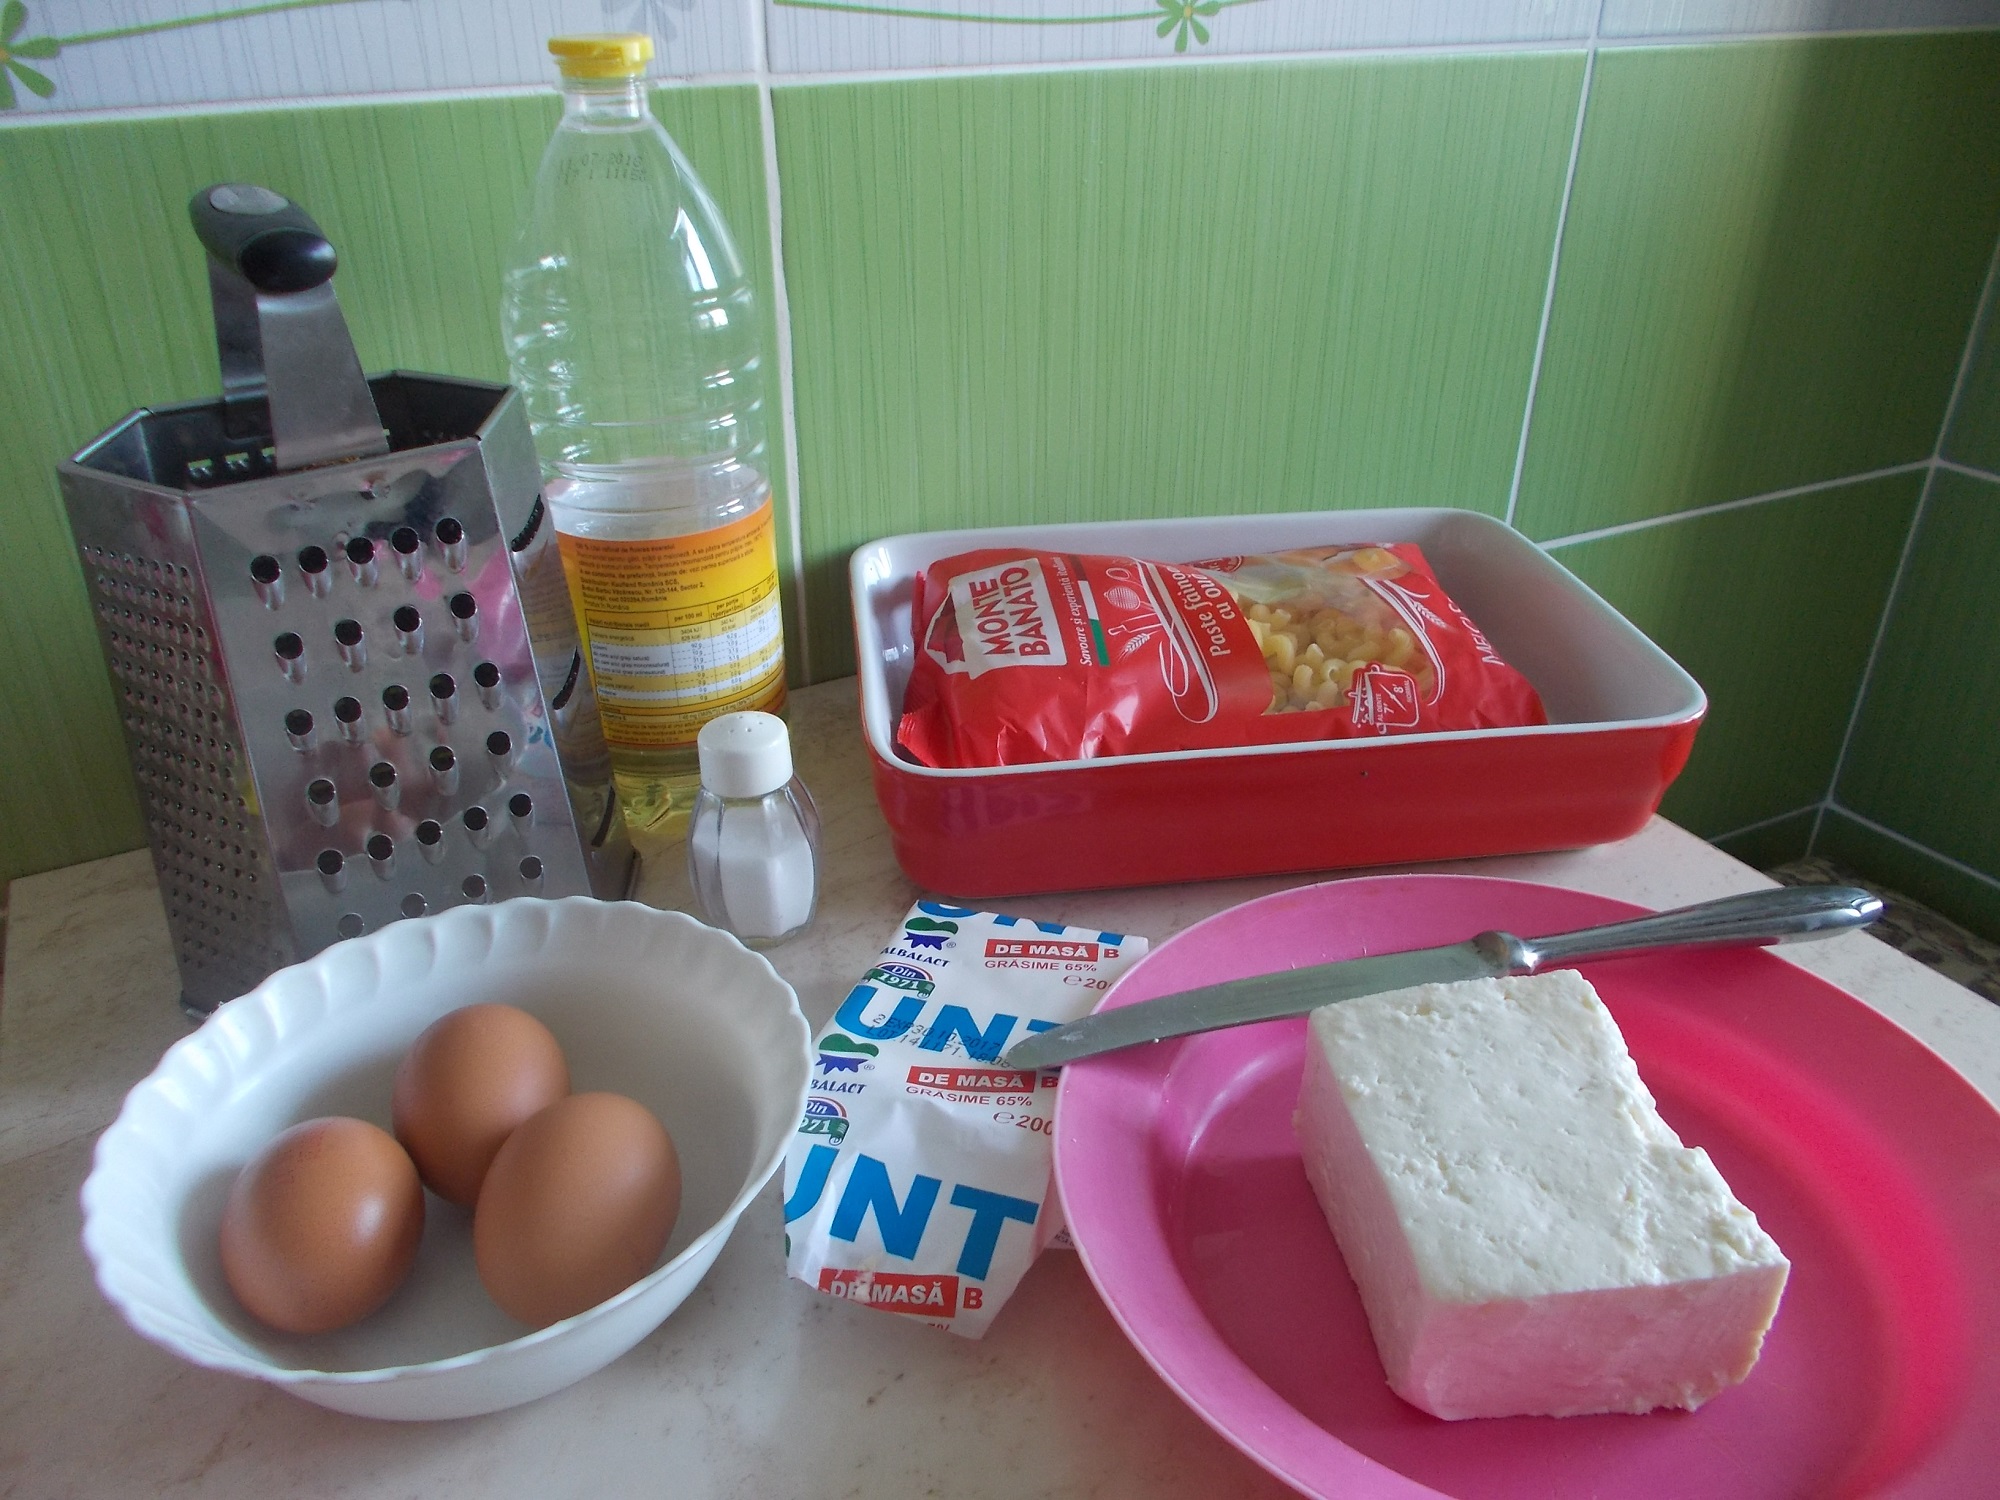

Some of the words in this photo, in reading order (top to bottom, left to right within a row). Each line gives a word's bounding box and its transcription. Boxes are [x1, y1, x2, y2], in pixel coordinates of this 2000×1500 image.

[969, 578, 1015, 656] MONTE
[1001, 567, 1051, 656] BANATO
[1216, 602, 1236, 620] cu
[1197, 611, 1232, 657] Paste
[1075, 627, 1093, 667] Savoare
[880, 946, 951, 968] ALBALACT
[995, 943, 1024, 955] DE
[1029, 945, 1089, 958] MASĂ
[1104, 948, 1120, 958] B
[891, 965, 917, 978] Din
[984, 958, 1060, 971] GRĂSIME
[1065, 963, 1097, 972] 65%
[878, 972, 920, 989] 1971
[811, 1079, 867, 1094] BALACT
[918, 1072, 950, 1085] DE
[956, 1073, 1025, 1089] MASĂ
[905, 1086, 990, 1105] GRĂSIME
[995, 1097, 1032, 1107] 65%
[801, 1117, 831, 1133] 971
[873, 1281, 945, 1307] MASĂ
[963, 1287, 984, 1310] B
